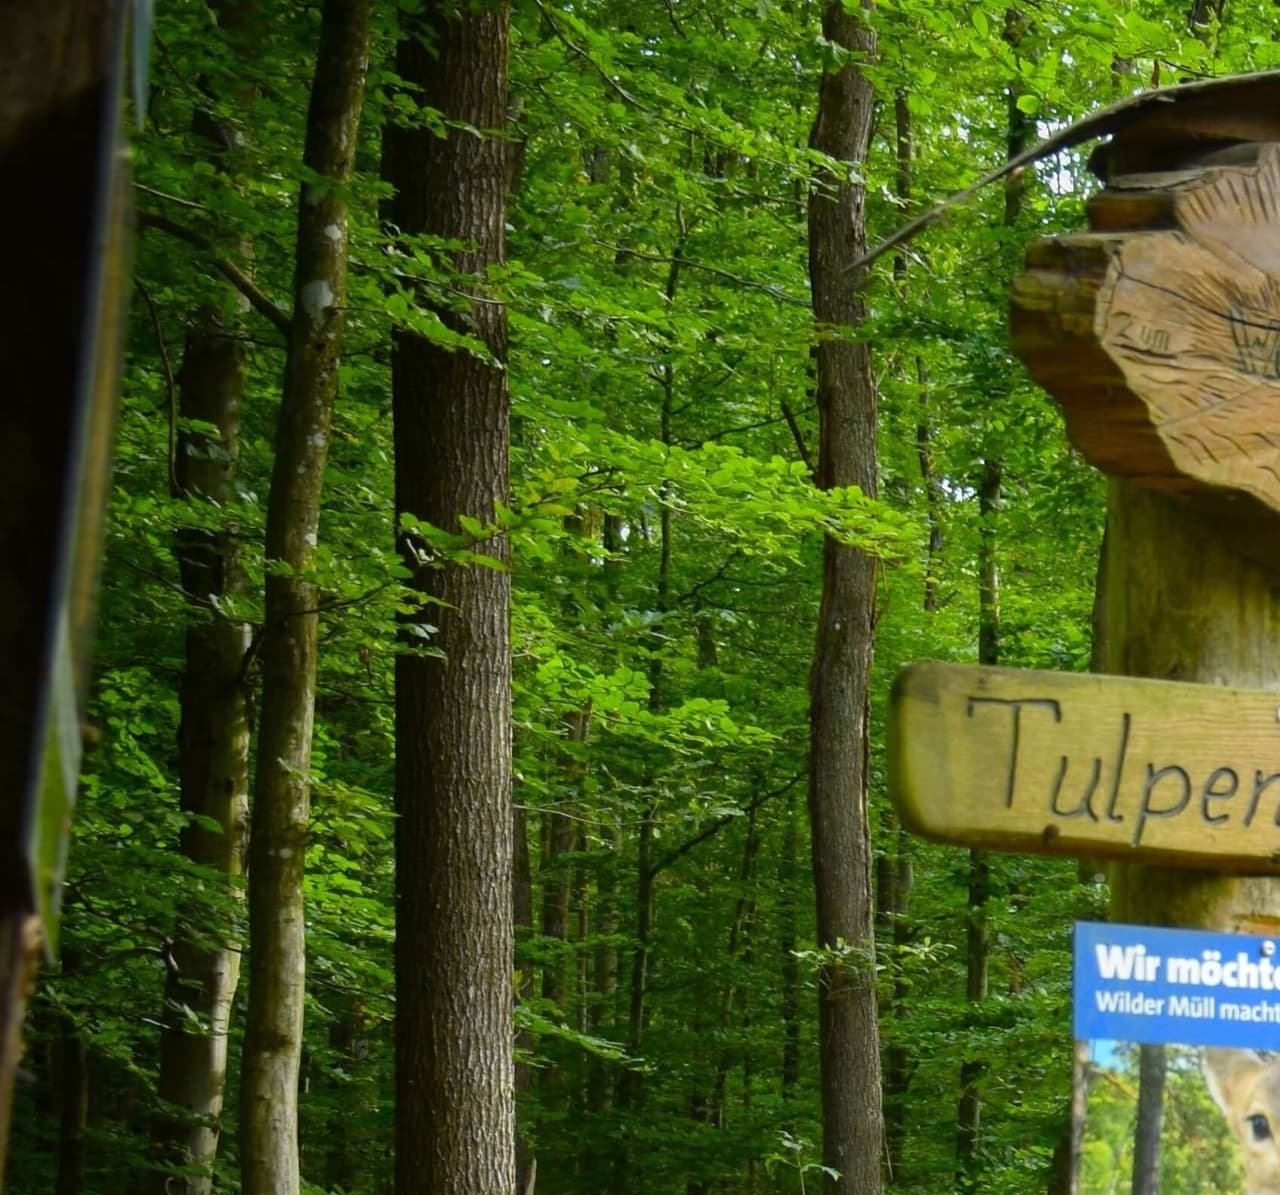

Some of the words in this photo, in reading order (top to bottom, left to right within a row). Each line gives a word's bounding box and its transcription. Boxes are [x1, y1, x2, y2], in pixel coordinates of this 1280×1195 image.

[1095, 943, 1160, 982] Wir
[1095, 990, 1164, 1016] Wilder
[1168, 995, 1215, 1019] Müll
